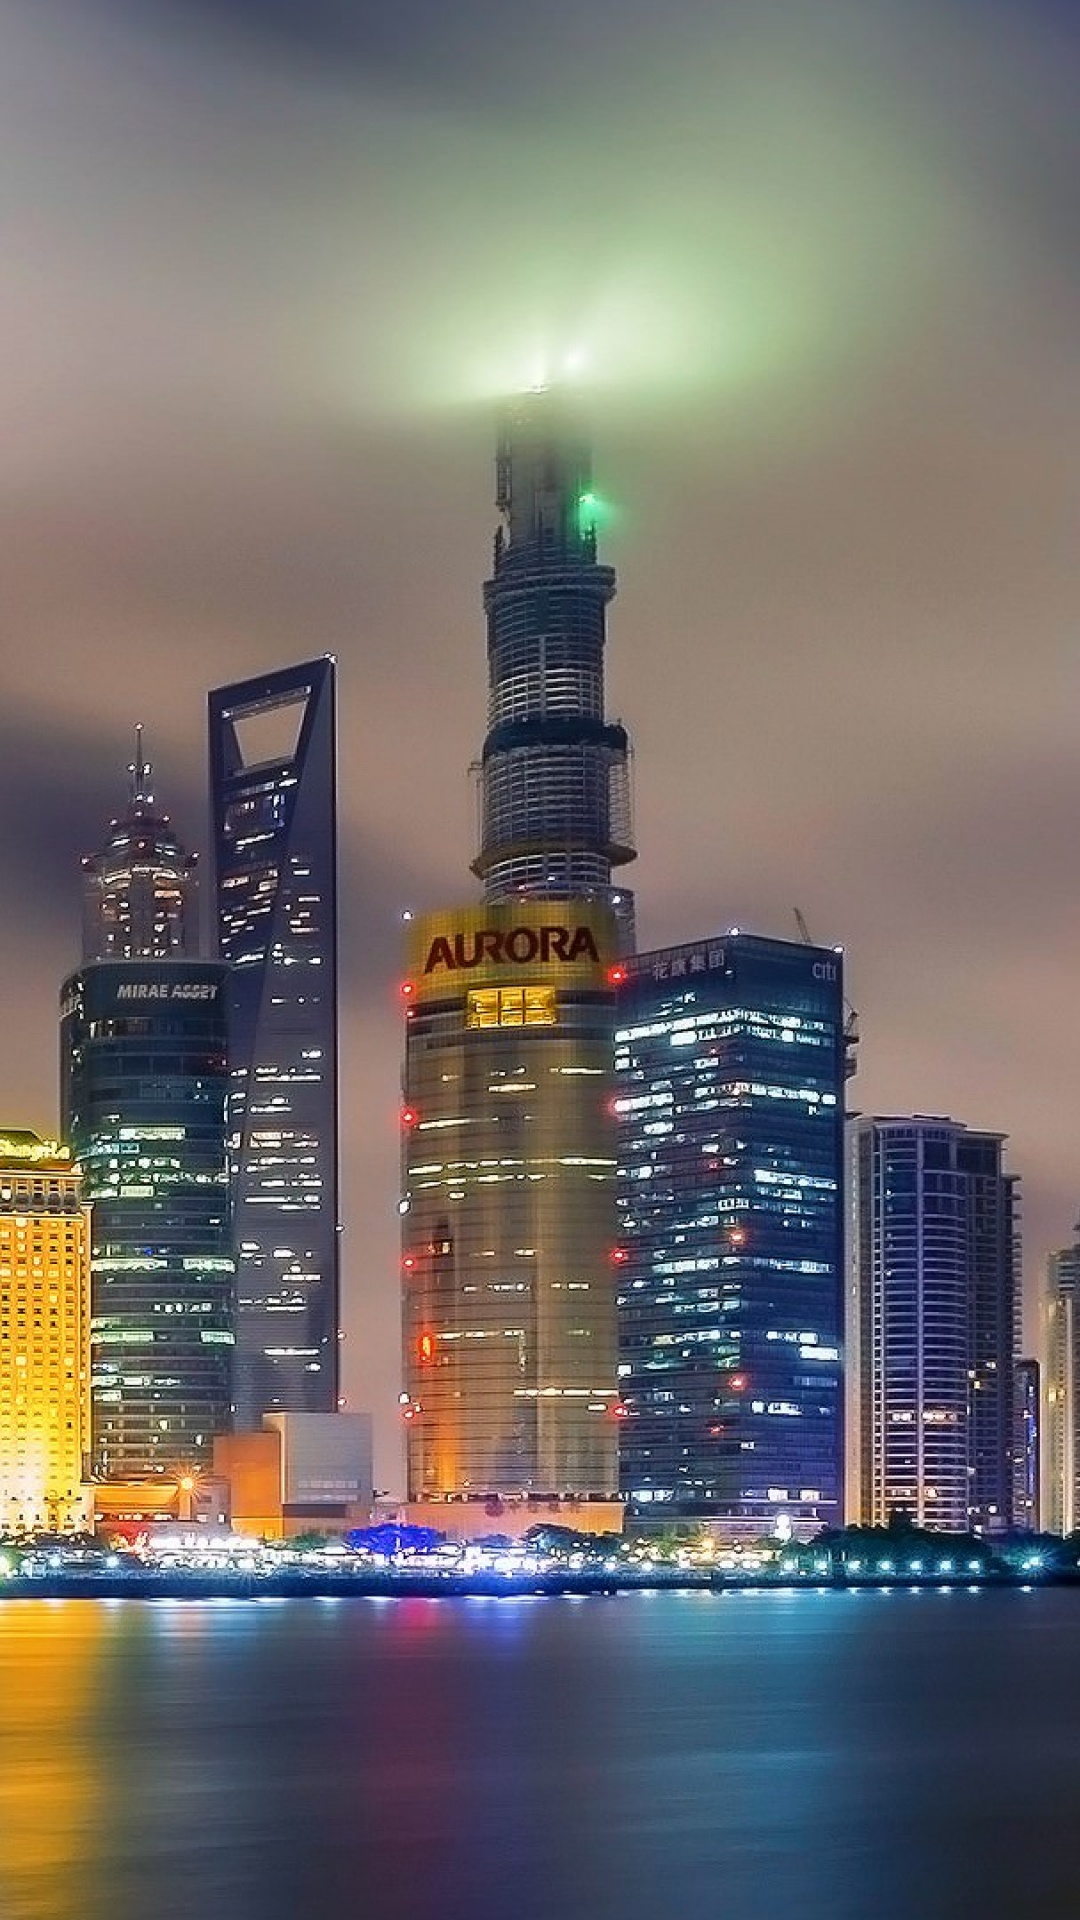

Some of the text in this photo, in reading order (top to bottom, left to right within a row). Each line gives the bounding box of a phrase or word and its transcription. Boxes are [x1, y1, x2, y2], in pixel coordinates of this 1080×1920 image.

[424, 926, 600, 974] AURORA
[117, 984, 218, 1000] MIRAE ASSET
